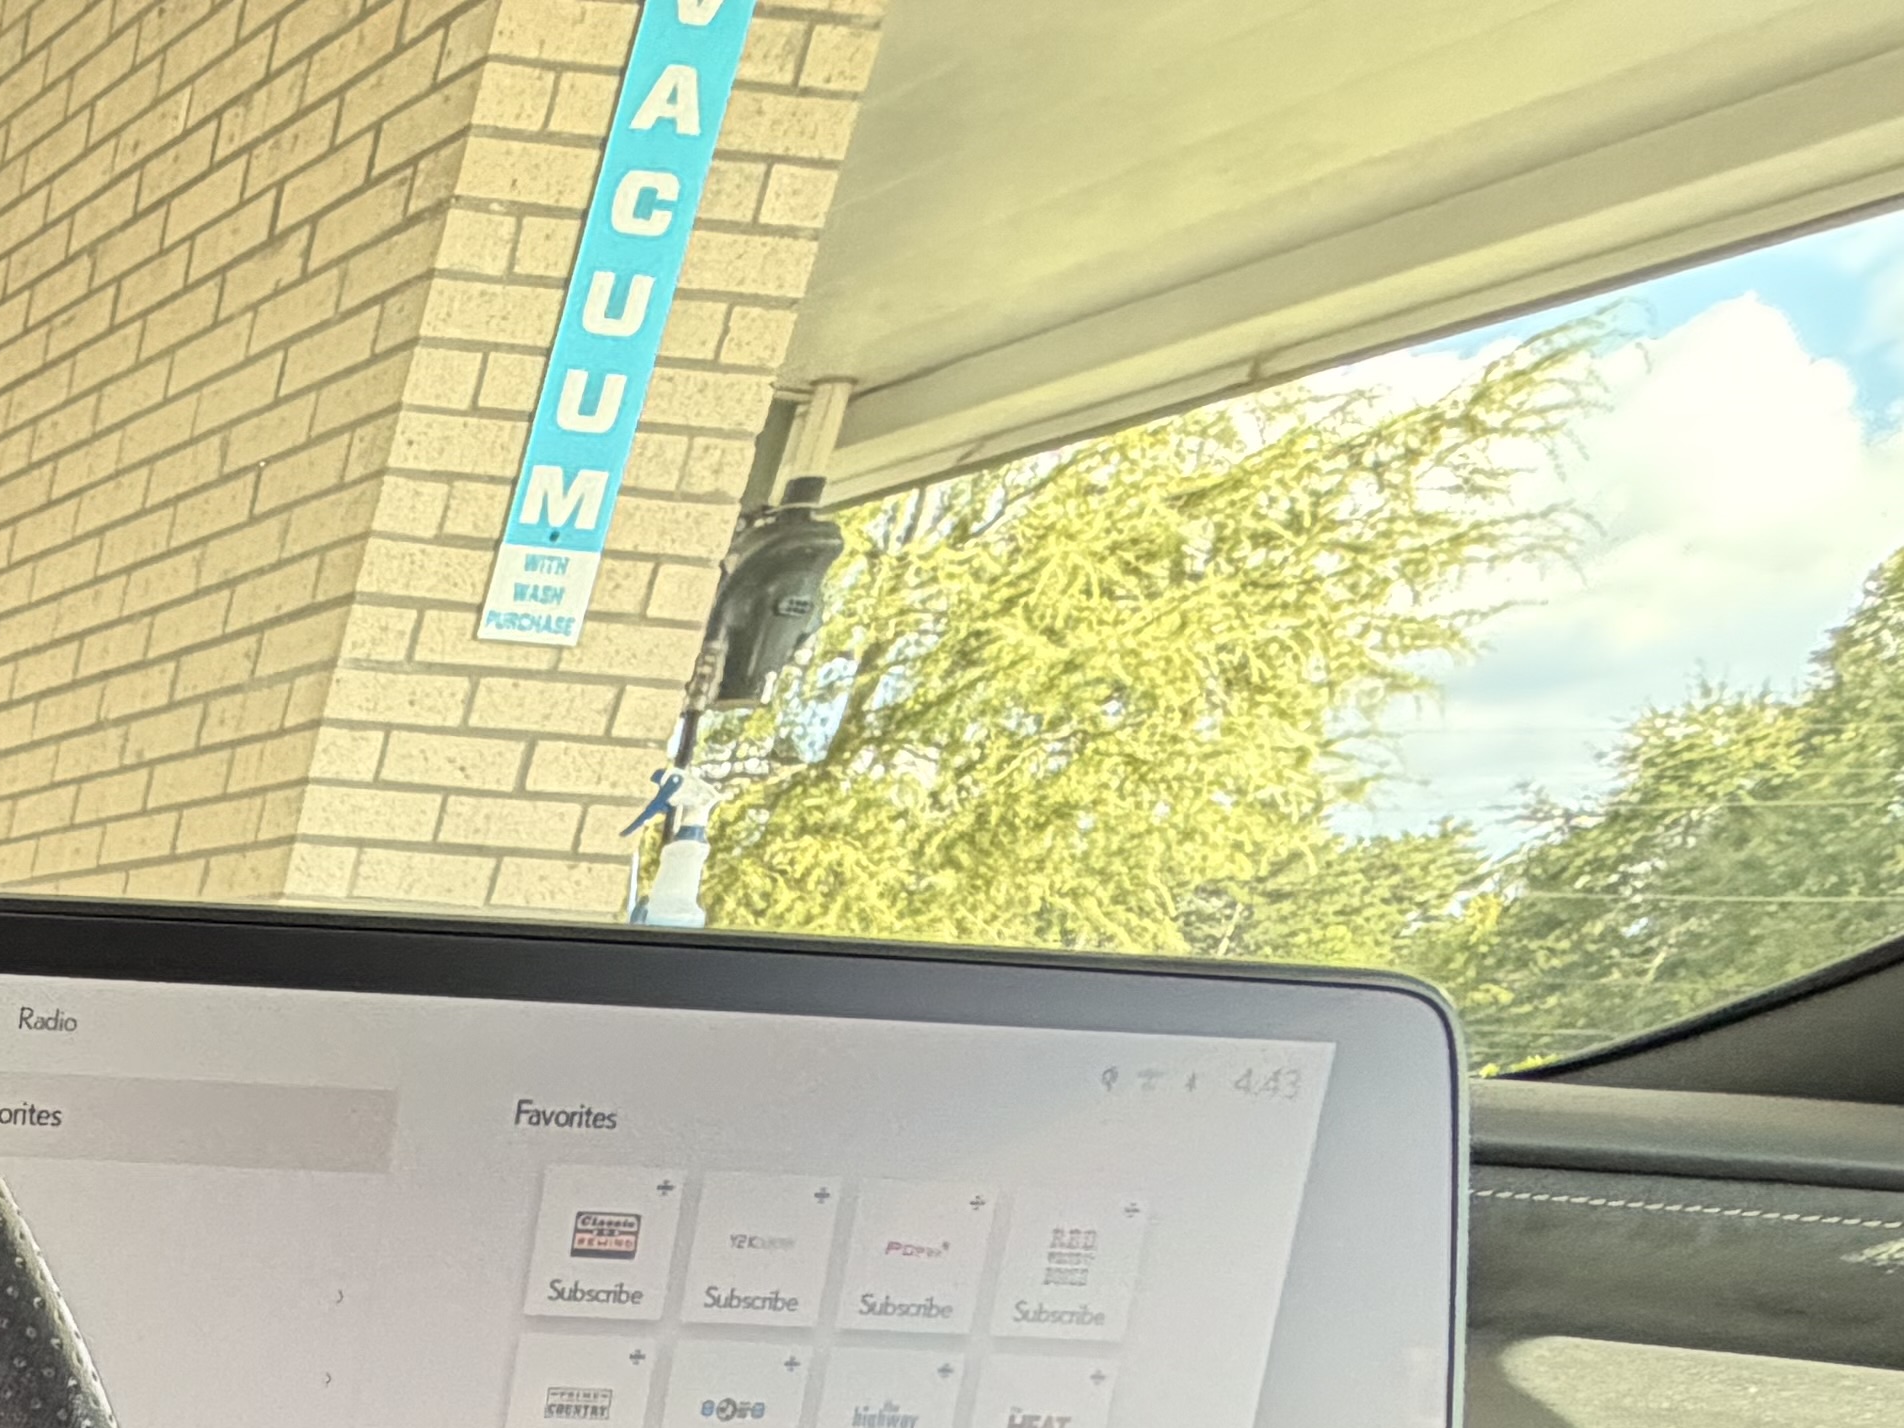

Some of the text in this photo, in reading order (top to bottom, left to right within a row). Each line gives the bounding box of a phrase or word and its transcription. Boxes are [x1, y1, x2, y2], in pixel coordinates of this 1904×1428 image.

[524, 553, 570, 575] WITH
[513, 582, 565, 605] WASH
[485, 610, 576, 636] PURCHASE
[18, 1005, 78, 1033] Radio
[514, 1099, 618, 1132] Favorites
[548, 1278, 644, 1305] Subscribe
[704, 1285, 798, 1312] Subscribe
[858, 1293, 953, 1319] Subscribe
[1013, 1300, 1105, 1326] Subscribe
